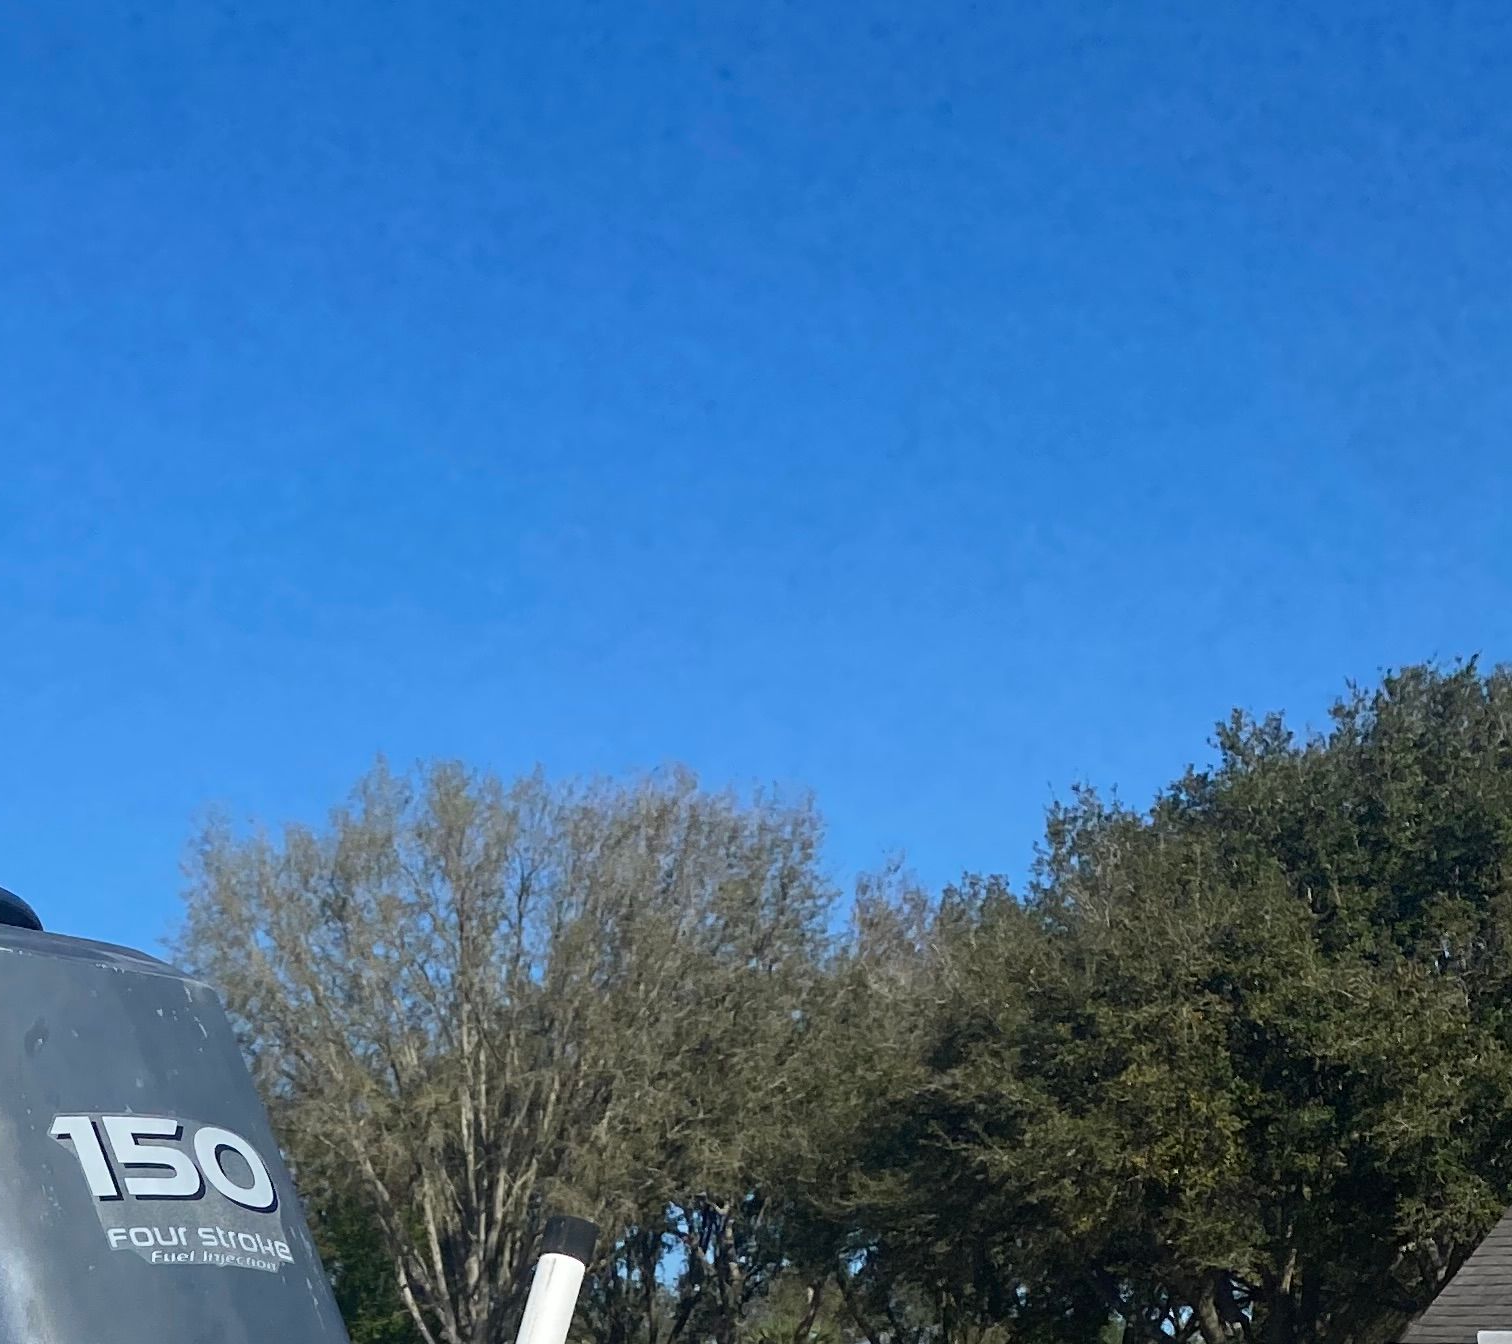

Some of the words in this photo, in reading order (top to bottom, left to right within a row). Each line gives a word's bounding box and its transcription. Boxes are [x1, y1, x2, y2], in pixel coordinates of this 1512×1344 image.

[50, 1115, 278, 1213] 150
[151, 1250, 195, 1263] Fuel
[202, 1250, 278, 1272] Injection
[197, 1226, 294, 1264] stroke
